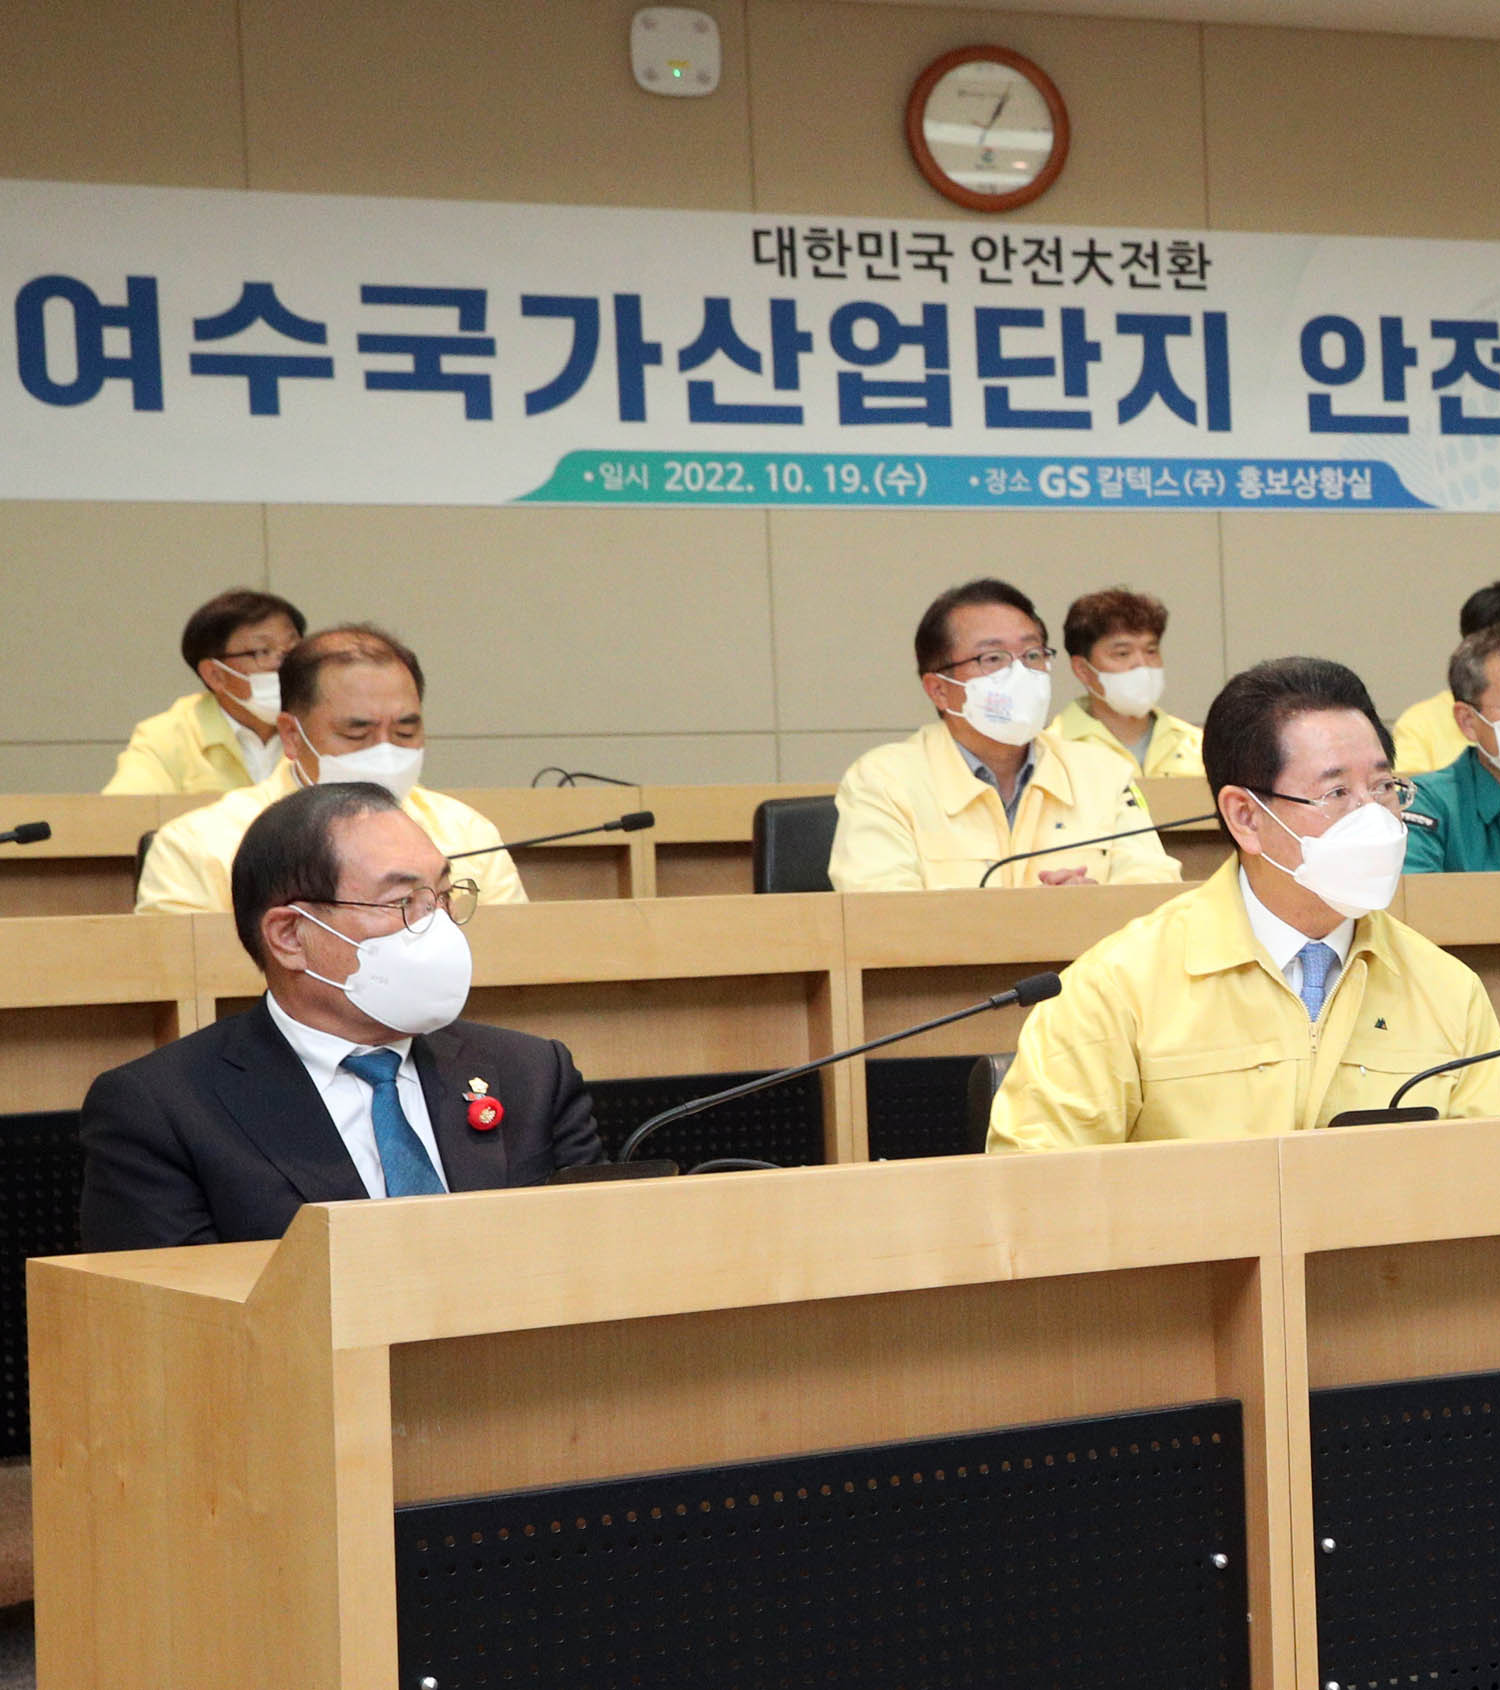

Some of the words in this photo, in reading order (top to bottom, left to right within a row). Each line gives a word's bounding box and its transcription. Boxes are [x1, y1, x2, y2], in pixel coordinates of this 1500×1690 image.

[752, 226, 954, 284] 대한민국
[971, 234, 1212, 291] 안전大전환
[15, 275, 1231, 432] 여수국가산업단지
[602, 462, 649, 490] 일시
[664, 461, 755, 493] 2022.
[765, 463, 813, 493] 10.
[823, 462, 928, 497] 19.(수)
[985, 467, 1032, 494] 장소
[1038, 465, 1092, 499] GS
[1236, 466, 1374, 500] 홍보상황실
